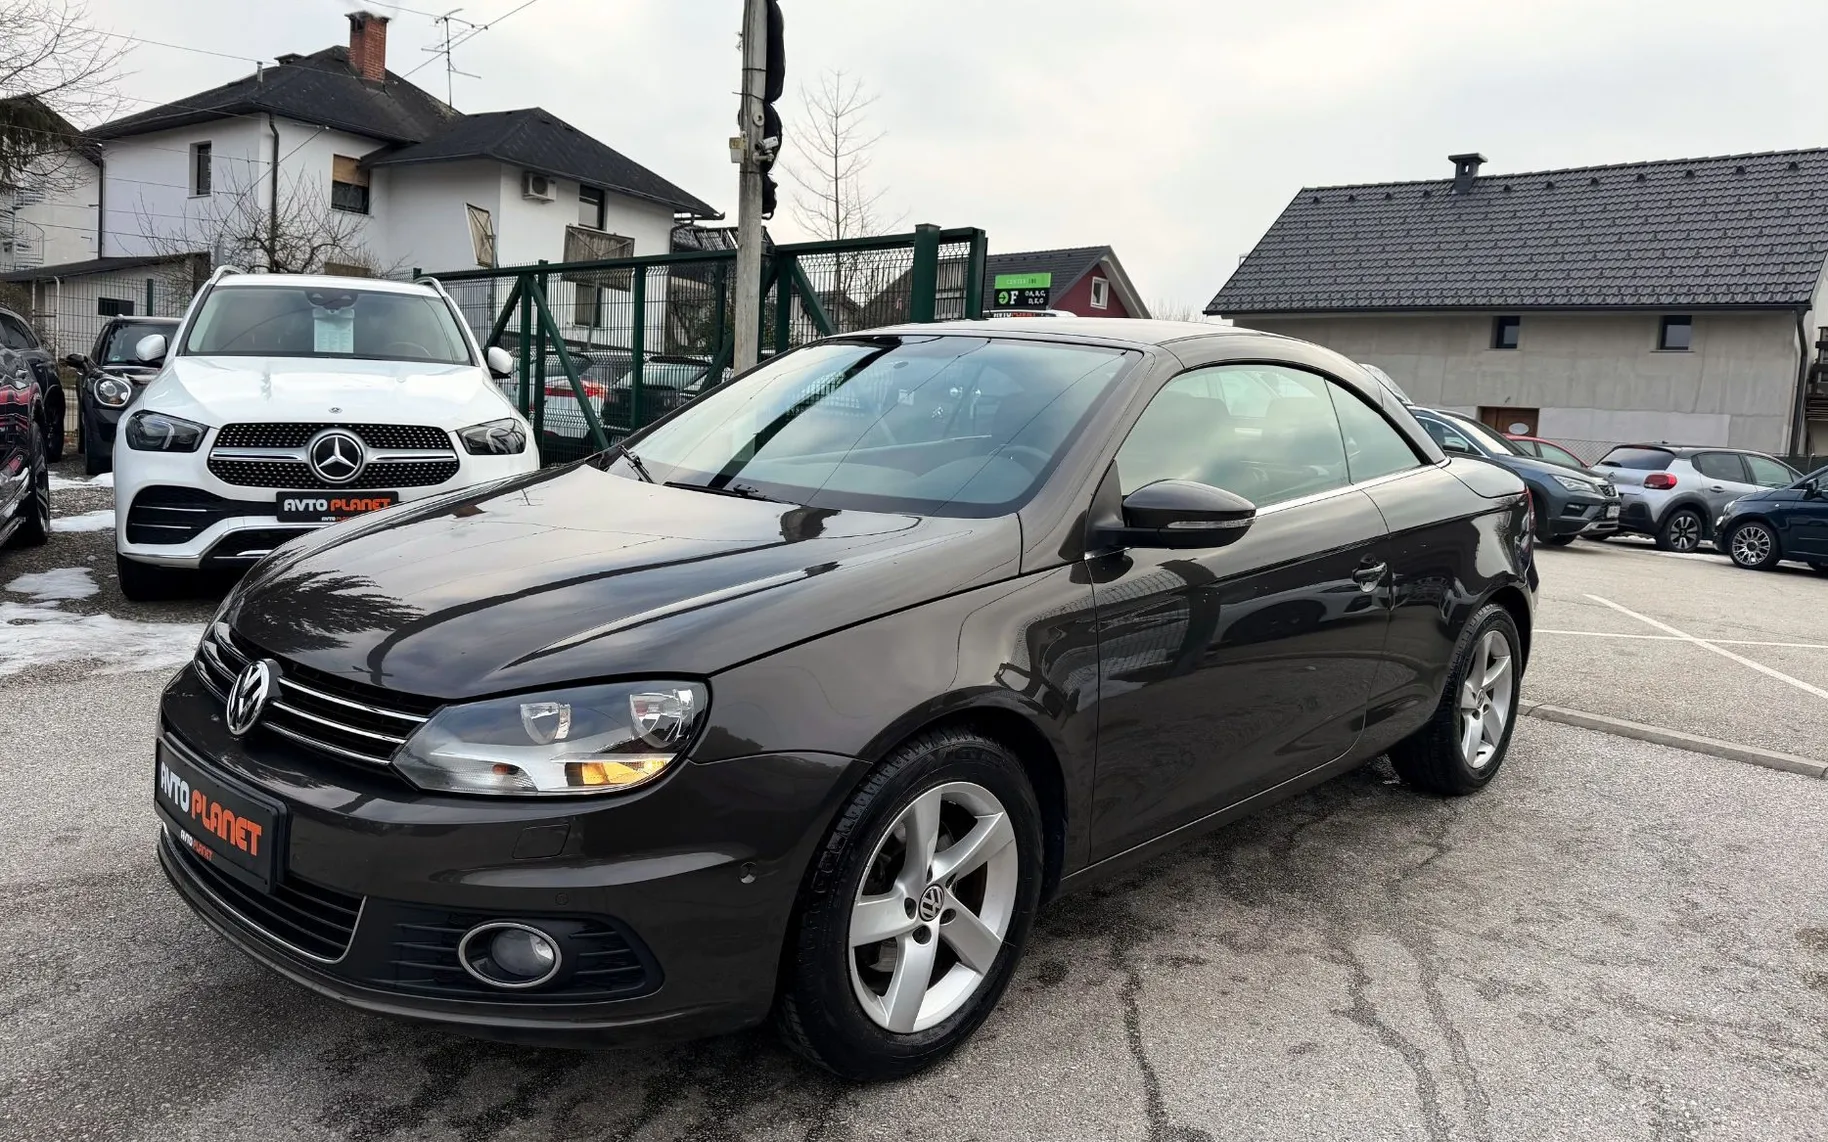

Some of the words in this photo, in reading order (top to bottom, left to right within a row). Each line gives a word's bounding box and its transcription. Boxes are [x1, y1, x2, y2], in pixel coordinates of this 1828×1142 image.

[1009, 290, 1019, 305] F
[283, 498, 328, 512] AVTO
[330, 498, 391, 511] PLANET
[160, 761, 190, 813] AVTO
[191, 789, 262, 857] PLANET
